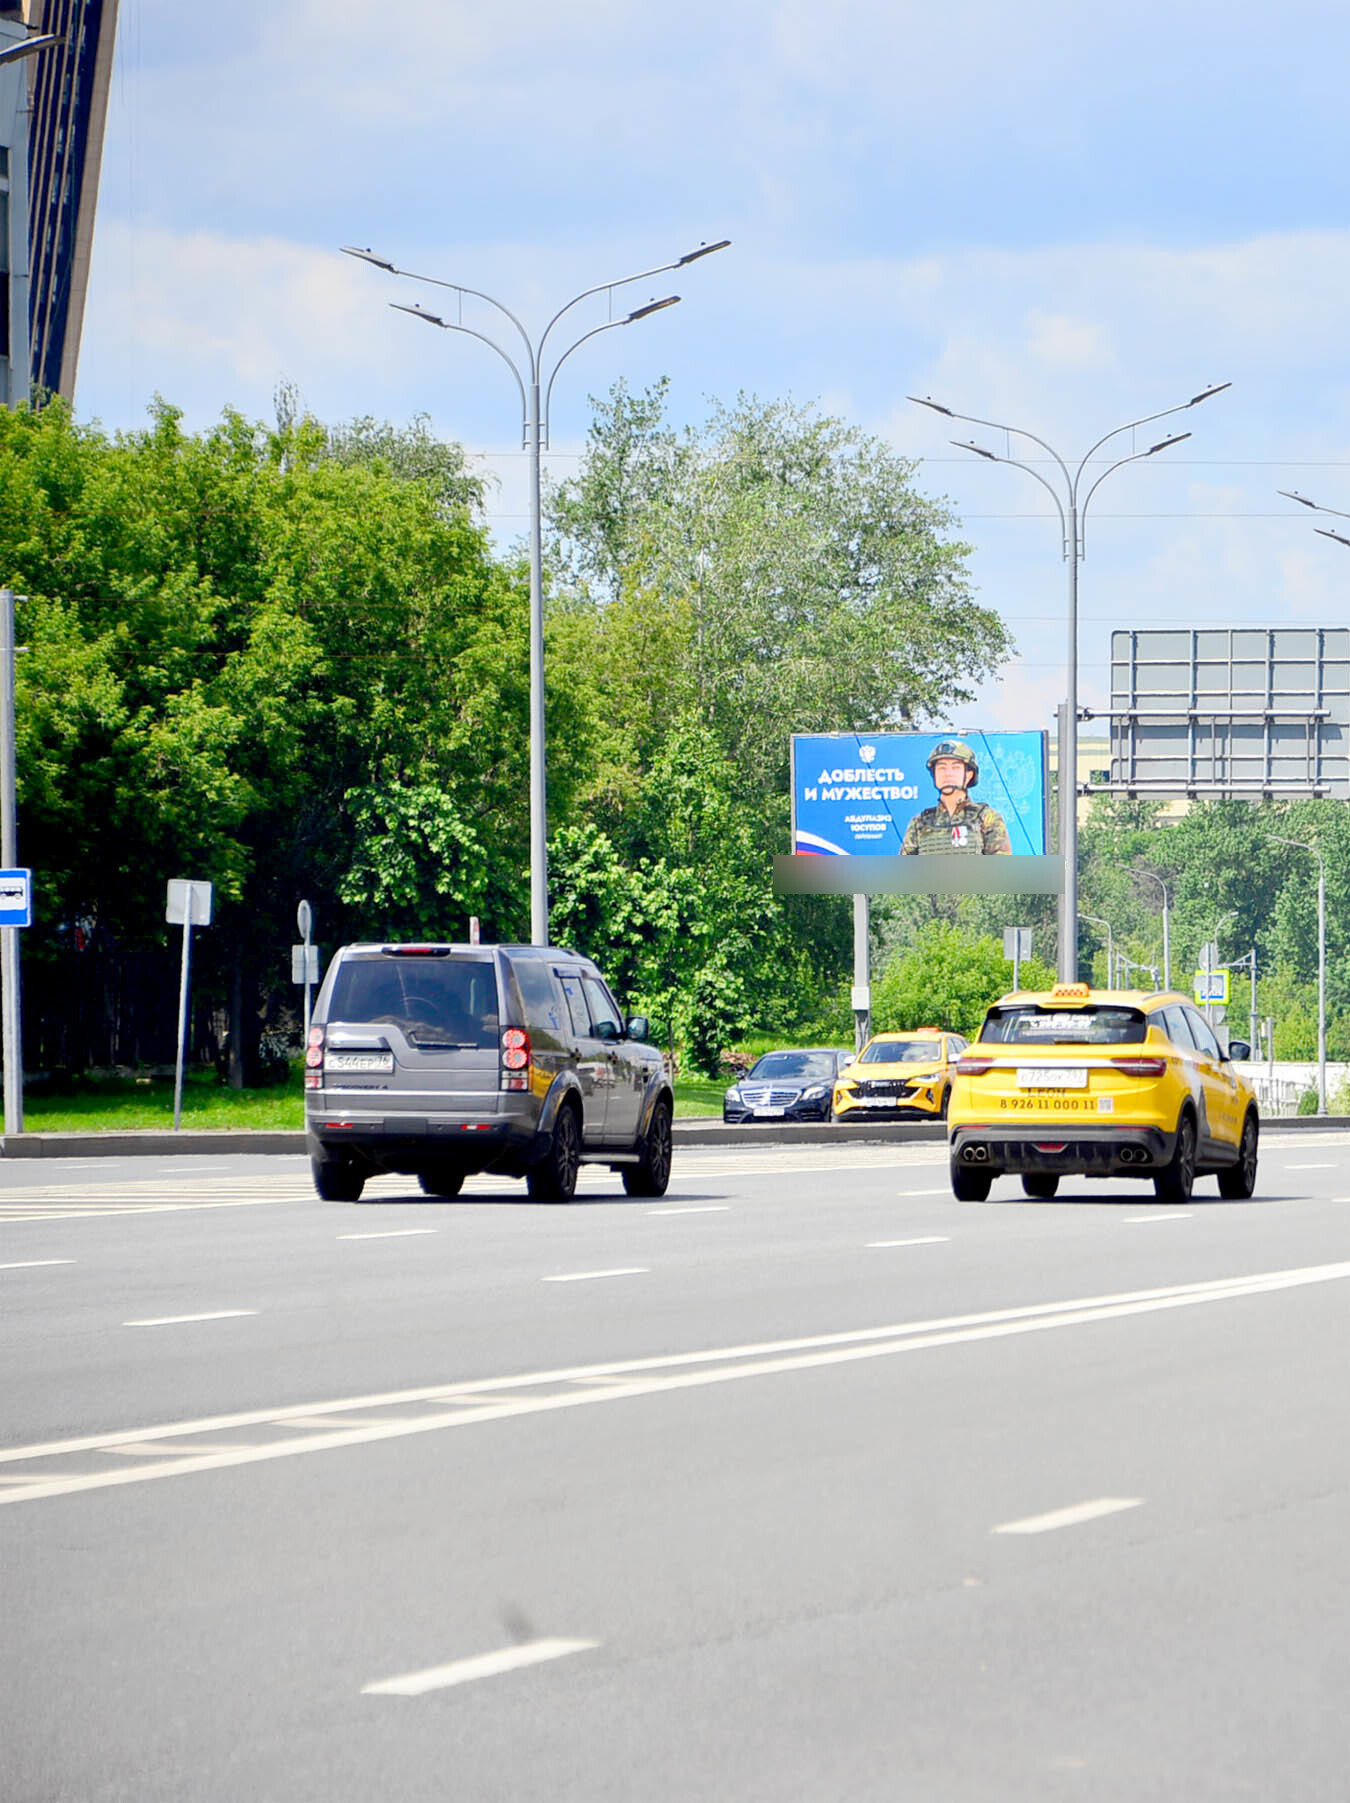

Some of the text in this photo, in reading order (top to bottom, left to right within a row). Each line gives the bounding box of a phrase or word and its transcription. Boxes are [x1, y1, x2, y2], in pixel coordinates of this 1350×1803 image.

[818, 768, 905, 784] ДОБЛЕСТЬ
[804, 786, 919, 801] И МУЖЕСТВО!
[1000, 1099, 1095, 1111] 8 926 11 000 11
